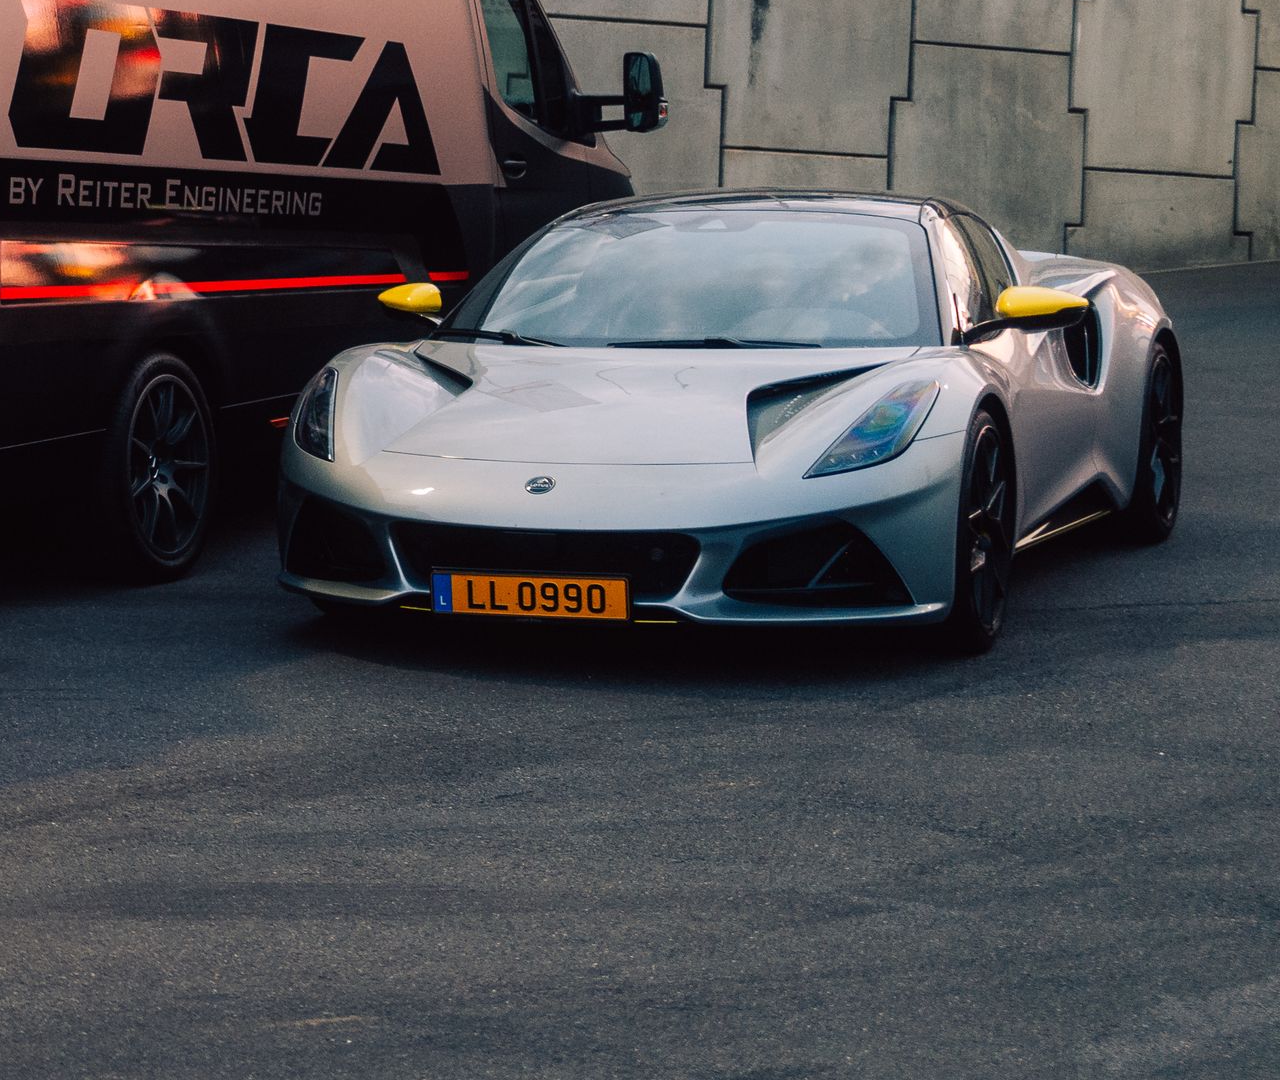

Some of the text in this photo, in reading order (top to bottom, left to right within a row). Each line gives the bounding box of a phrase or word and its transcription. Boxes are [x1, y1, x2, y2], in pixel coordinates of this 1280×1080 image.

[9, 176, 43, 205] BY
[440, 595, 447, 606] L
[467, 579, 606, 614] LL 0990
